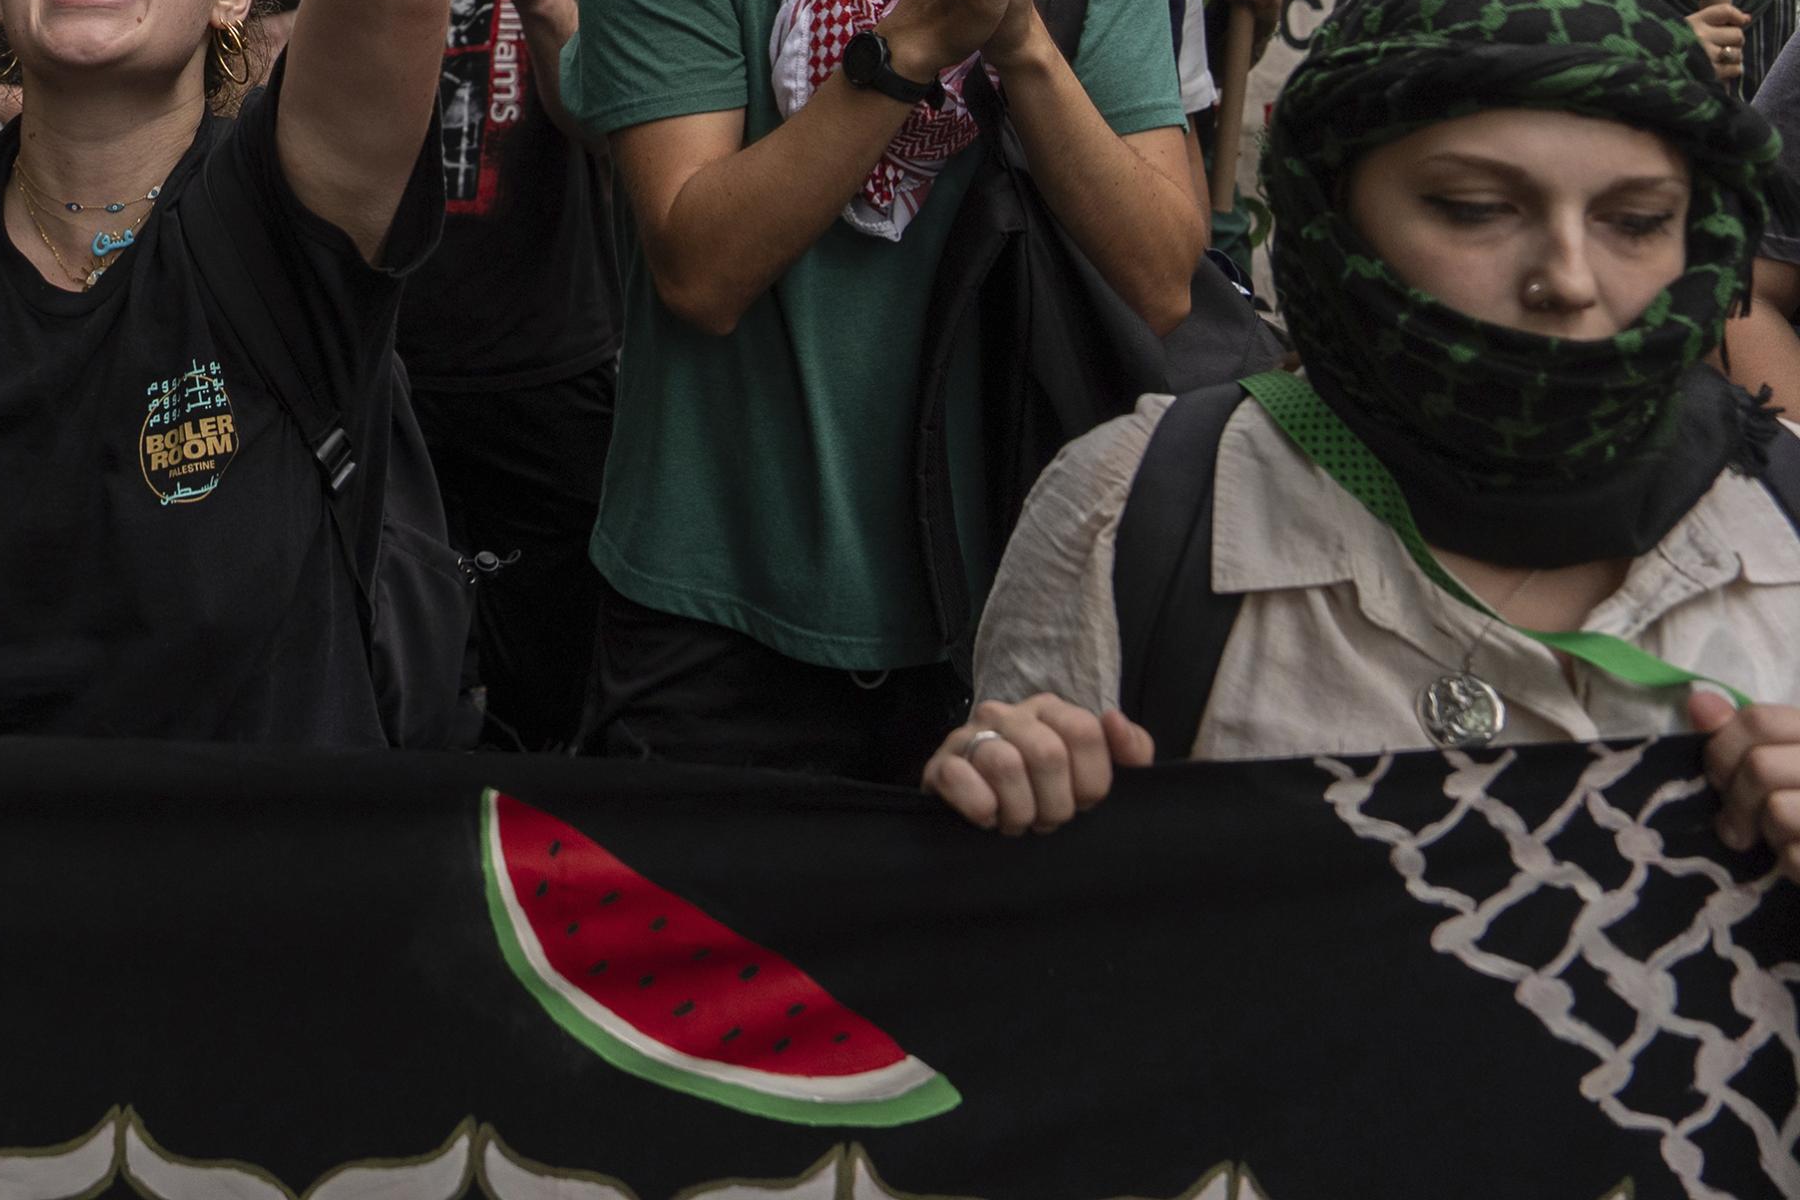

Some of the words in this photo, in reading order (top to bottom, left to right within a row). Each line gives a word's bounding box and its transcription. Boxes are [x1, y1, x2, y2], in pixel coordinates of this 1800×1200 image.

[145, 414, 234, 454] BOILER
[151, 433, 233, 471] ROOM
[160, 473, 219, 506] فلسطين
